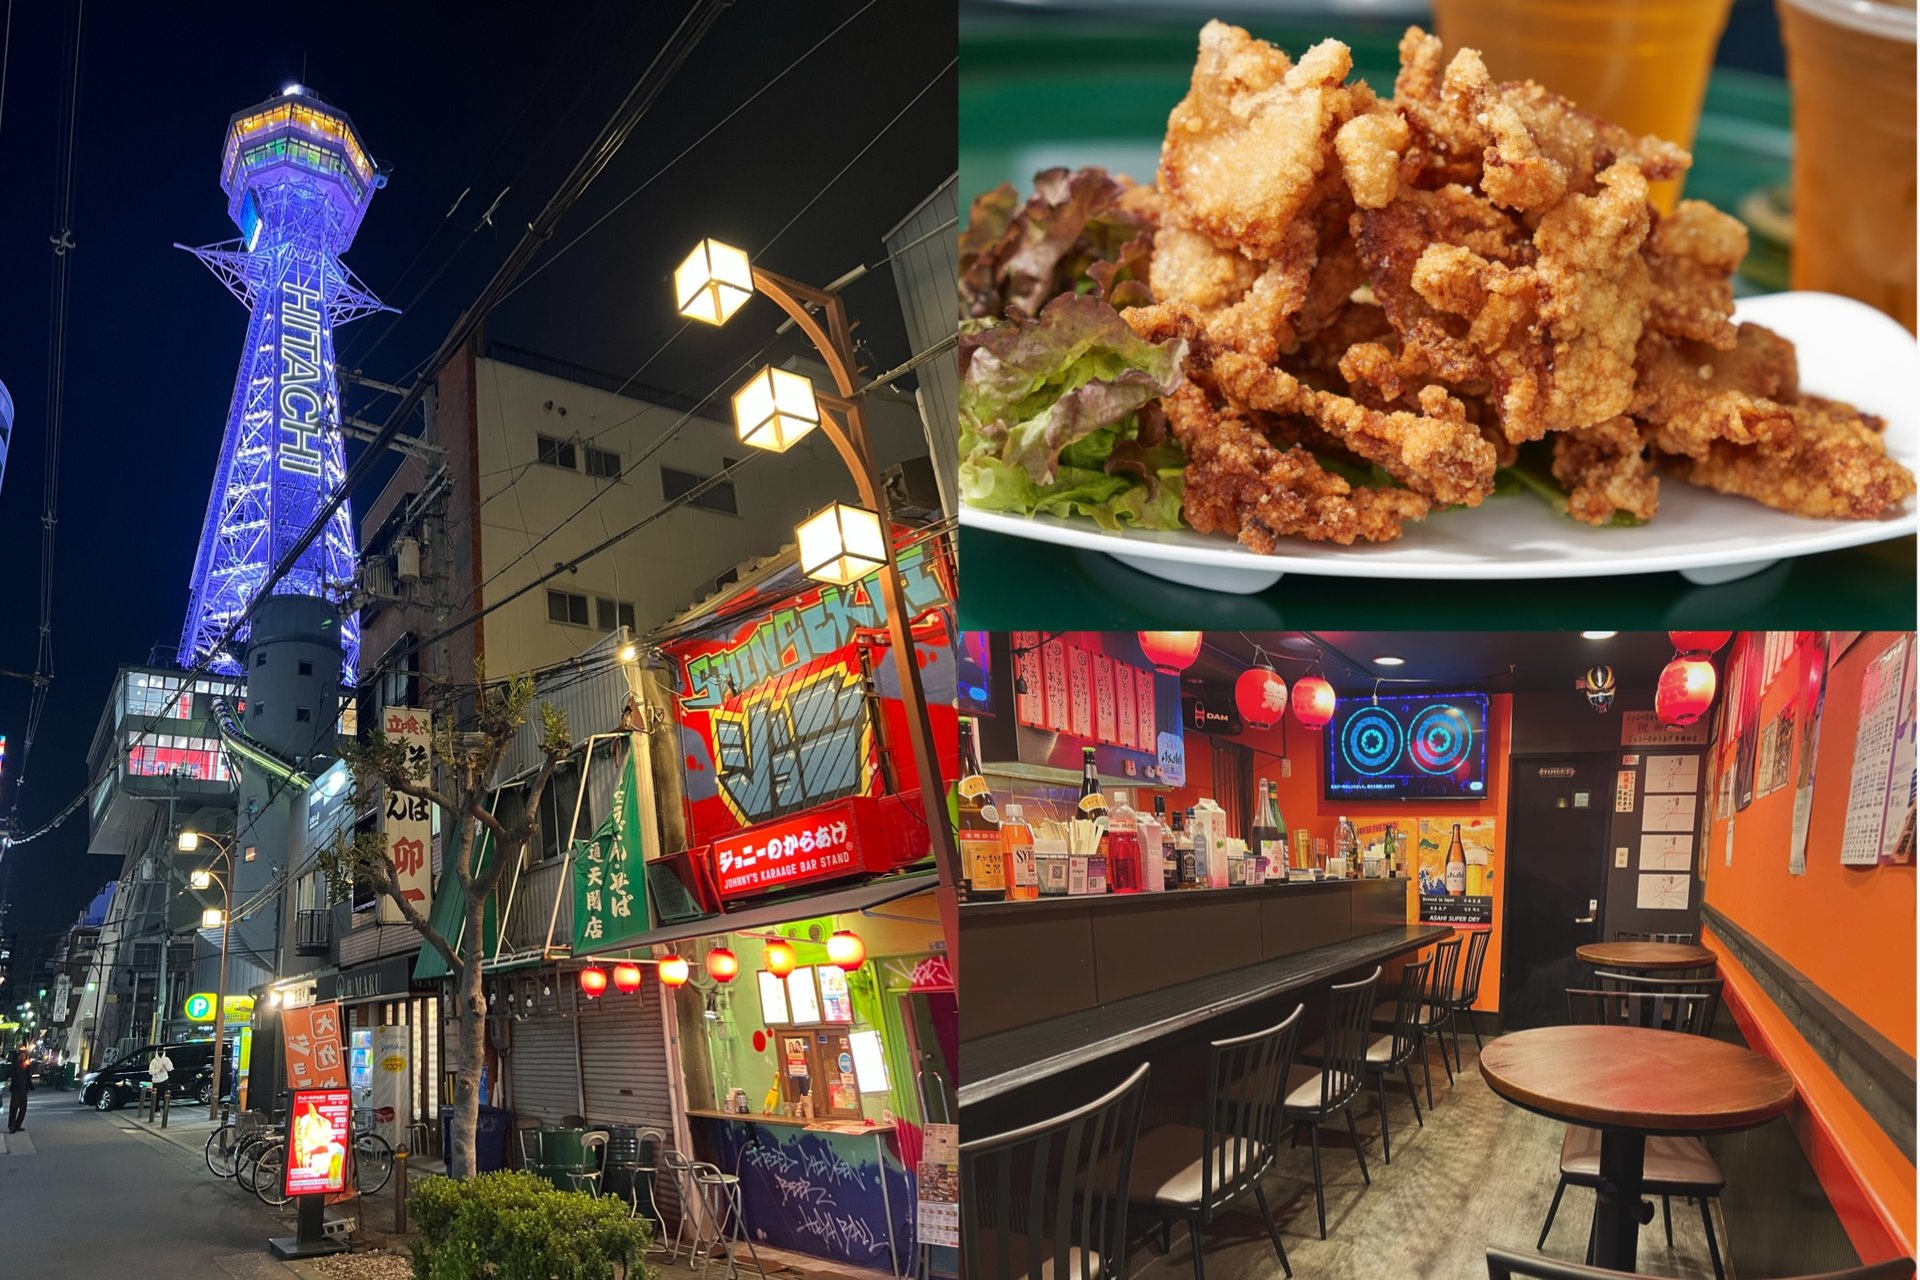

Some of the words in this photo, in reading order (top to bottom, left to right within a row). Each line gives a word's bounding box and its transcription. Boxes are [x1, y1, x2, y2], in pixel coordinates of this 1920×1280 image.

[280, 281, 321, 476] HITACHI
[1207, 713, 1229, 721] DAM
[719, 820, 848, 874] ジョニーのからあげ
[724, 873, 758, 890] JOHNNY'S
[760, 864, 797, 881] KARAAGE
[800, 858, 817, 872] BAR
[820, 851, 850, 868] STAND
[193, 998, 207, 1017] P
